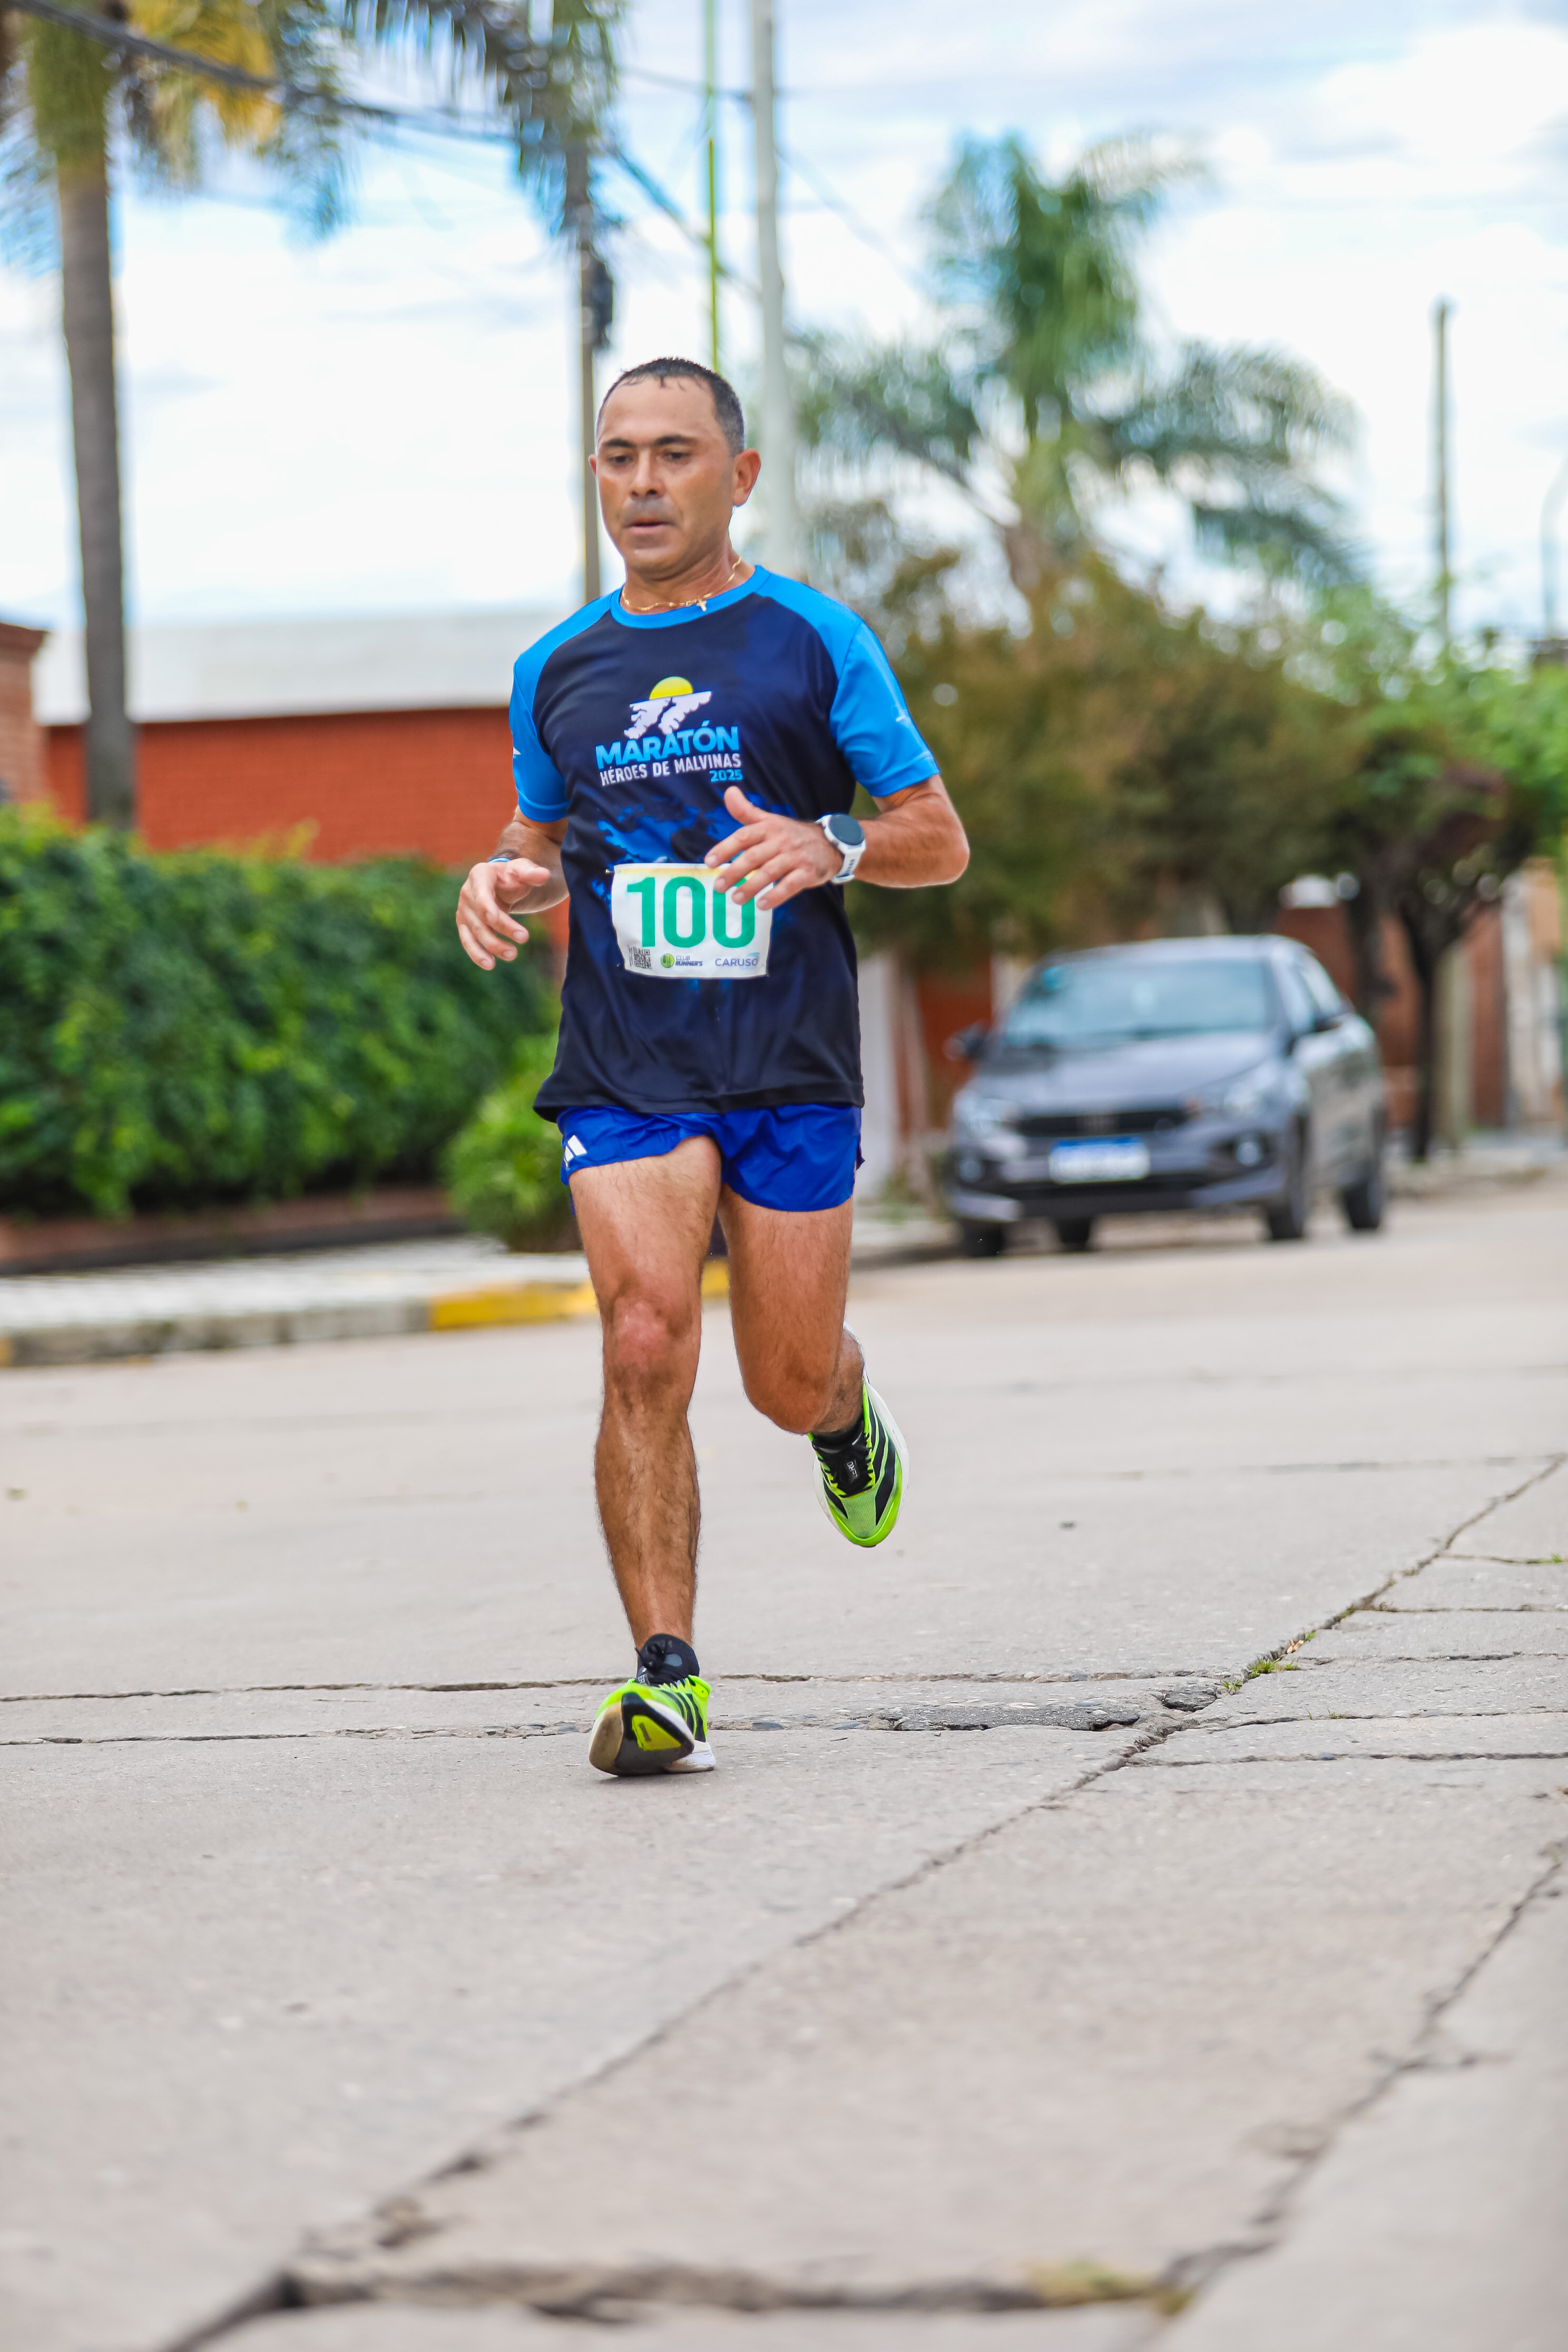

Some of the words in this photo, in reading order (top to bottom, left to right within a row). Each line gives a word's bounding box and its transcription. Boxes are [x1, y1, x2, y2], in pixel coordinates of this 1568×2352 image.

[595, 720, 740, 769] MARATÓN
[600, 763, 648, 786] HÉROES
[652, 761, 670, 777] DE
[674, 753, 741, 773] MALVINAS
[709, 769, 743, 782] 2025
[627, 876, 755, 948] 100
[715, 958, 758, 966] CARUSO
